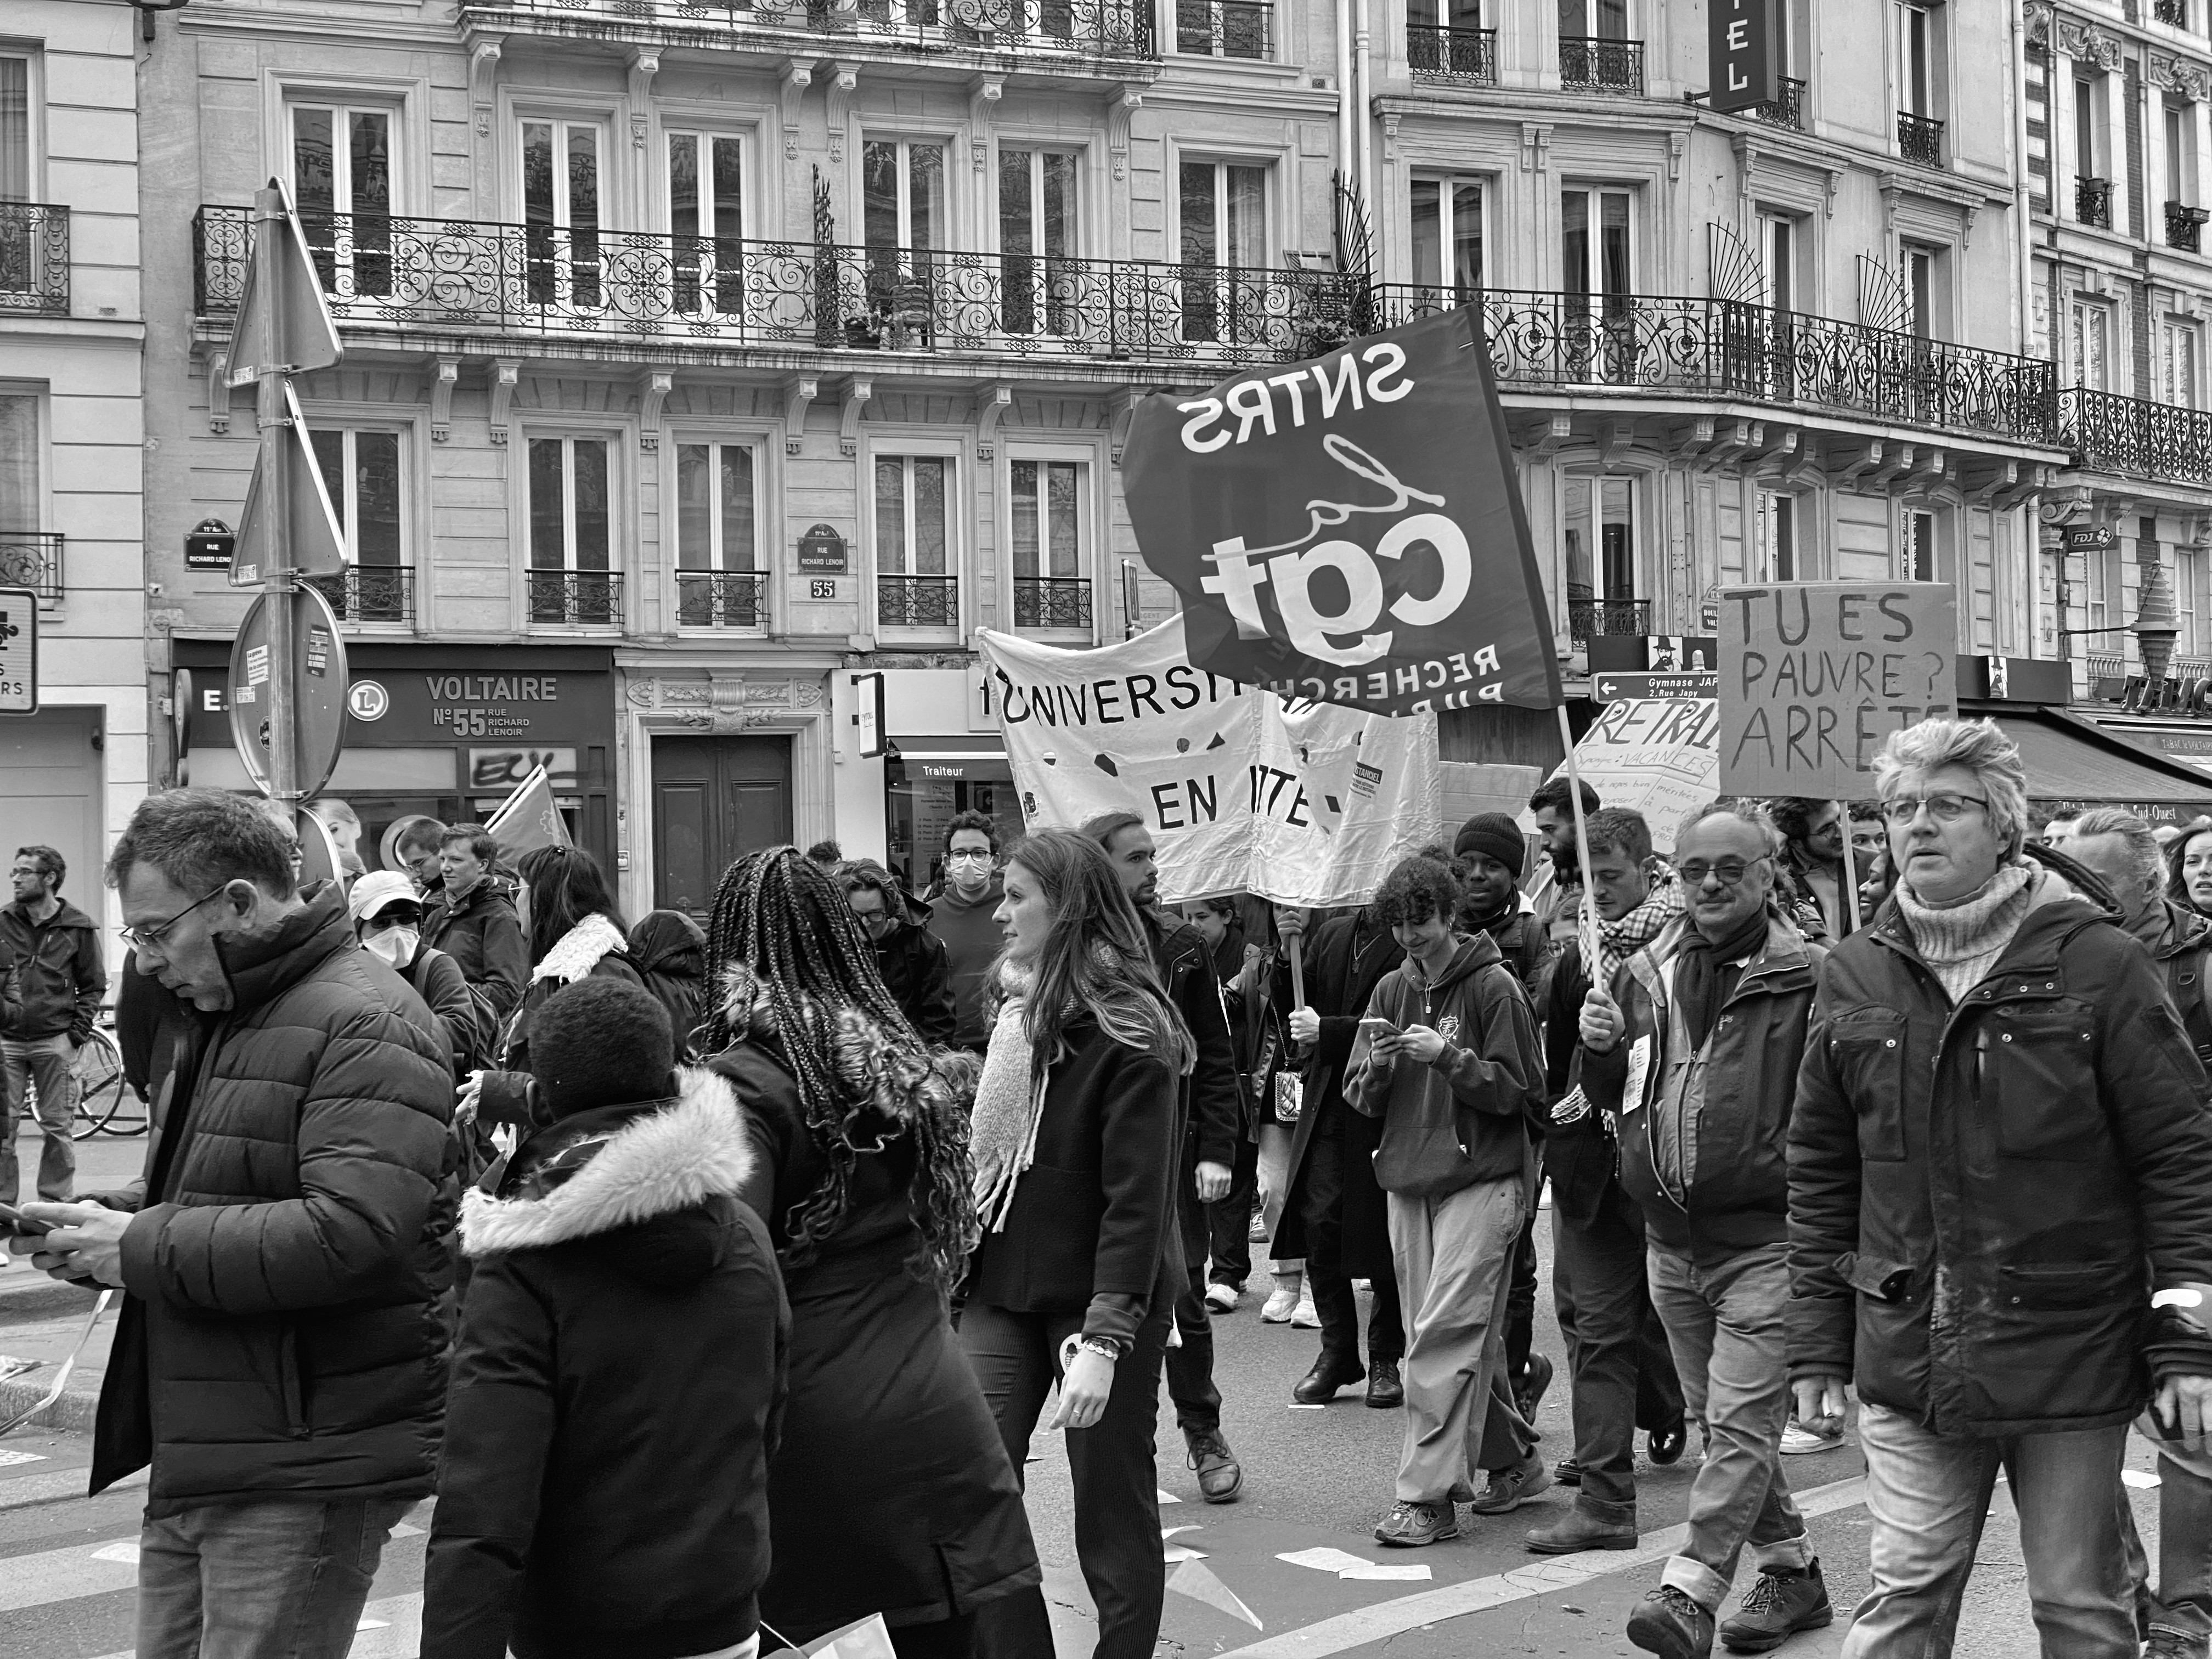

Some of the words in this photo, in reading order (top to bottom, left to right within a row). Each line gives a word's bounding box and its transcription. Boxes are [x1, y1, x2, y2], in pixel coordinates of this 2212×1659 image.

[2074, 533, 2094, 543] FDJ
[813, 582, 833, 597] 55
[1724, 588, 1810, 646] TU
[1839, 592, 1914, 642] ES
[1649, 678, 1693, 689] Gymnase
[1742, 650, 1908, 702] PAUVRE
[426, 676, 557, 701] VOLTAIRE
[1679, 689, 1698, 698] Japy
[1730, 697, 1951, 772] ARRÊT
[2162, 738, 2182, 749] TABAC
[922, 766, 963, 776] Traiteur
[1623, 751, 1713, 775] VACANCES
[1150, 775, 1217, 830] EN
